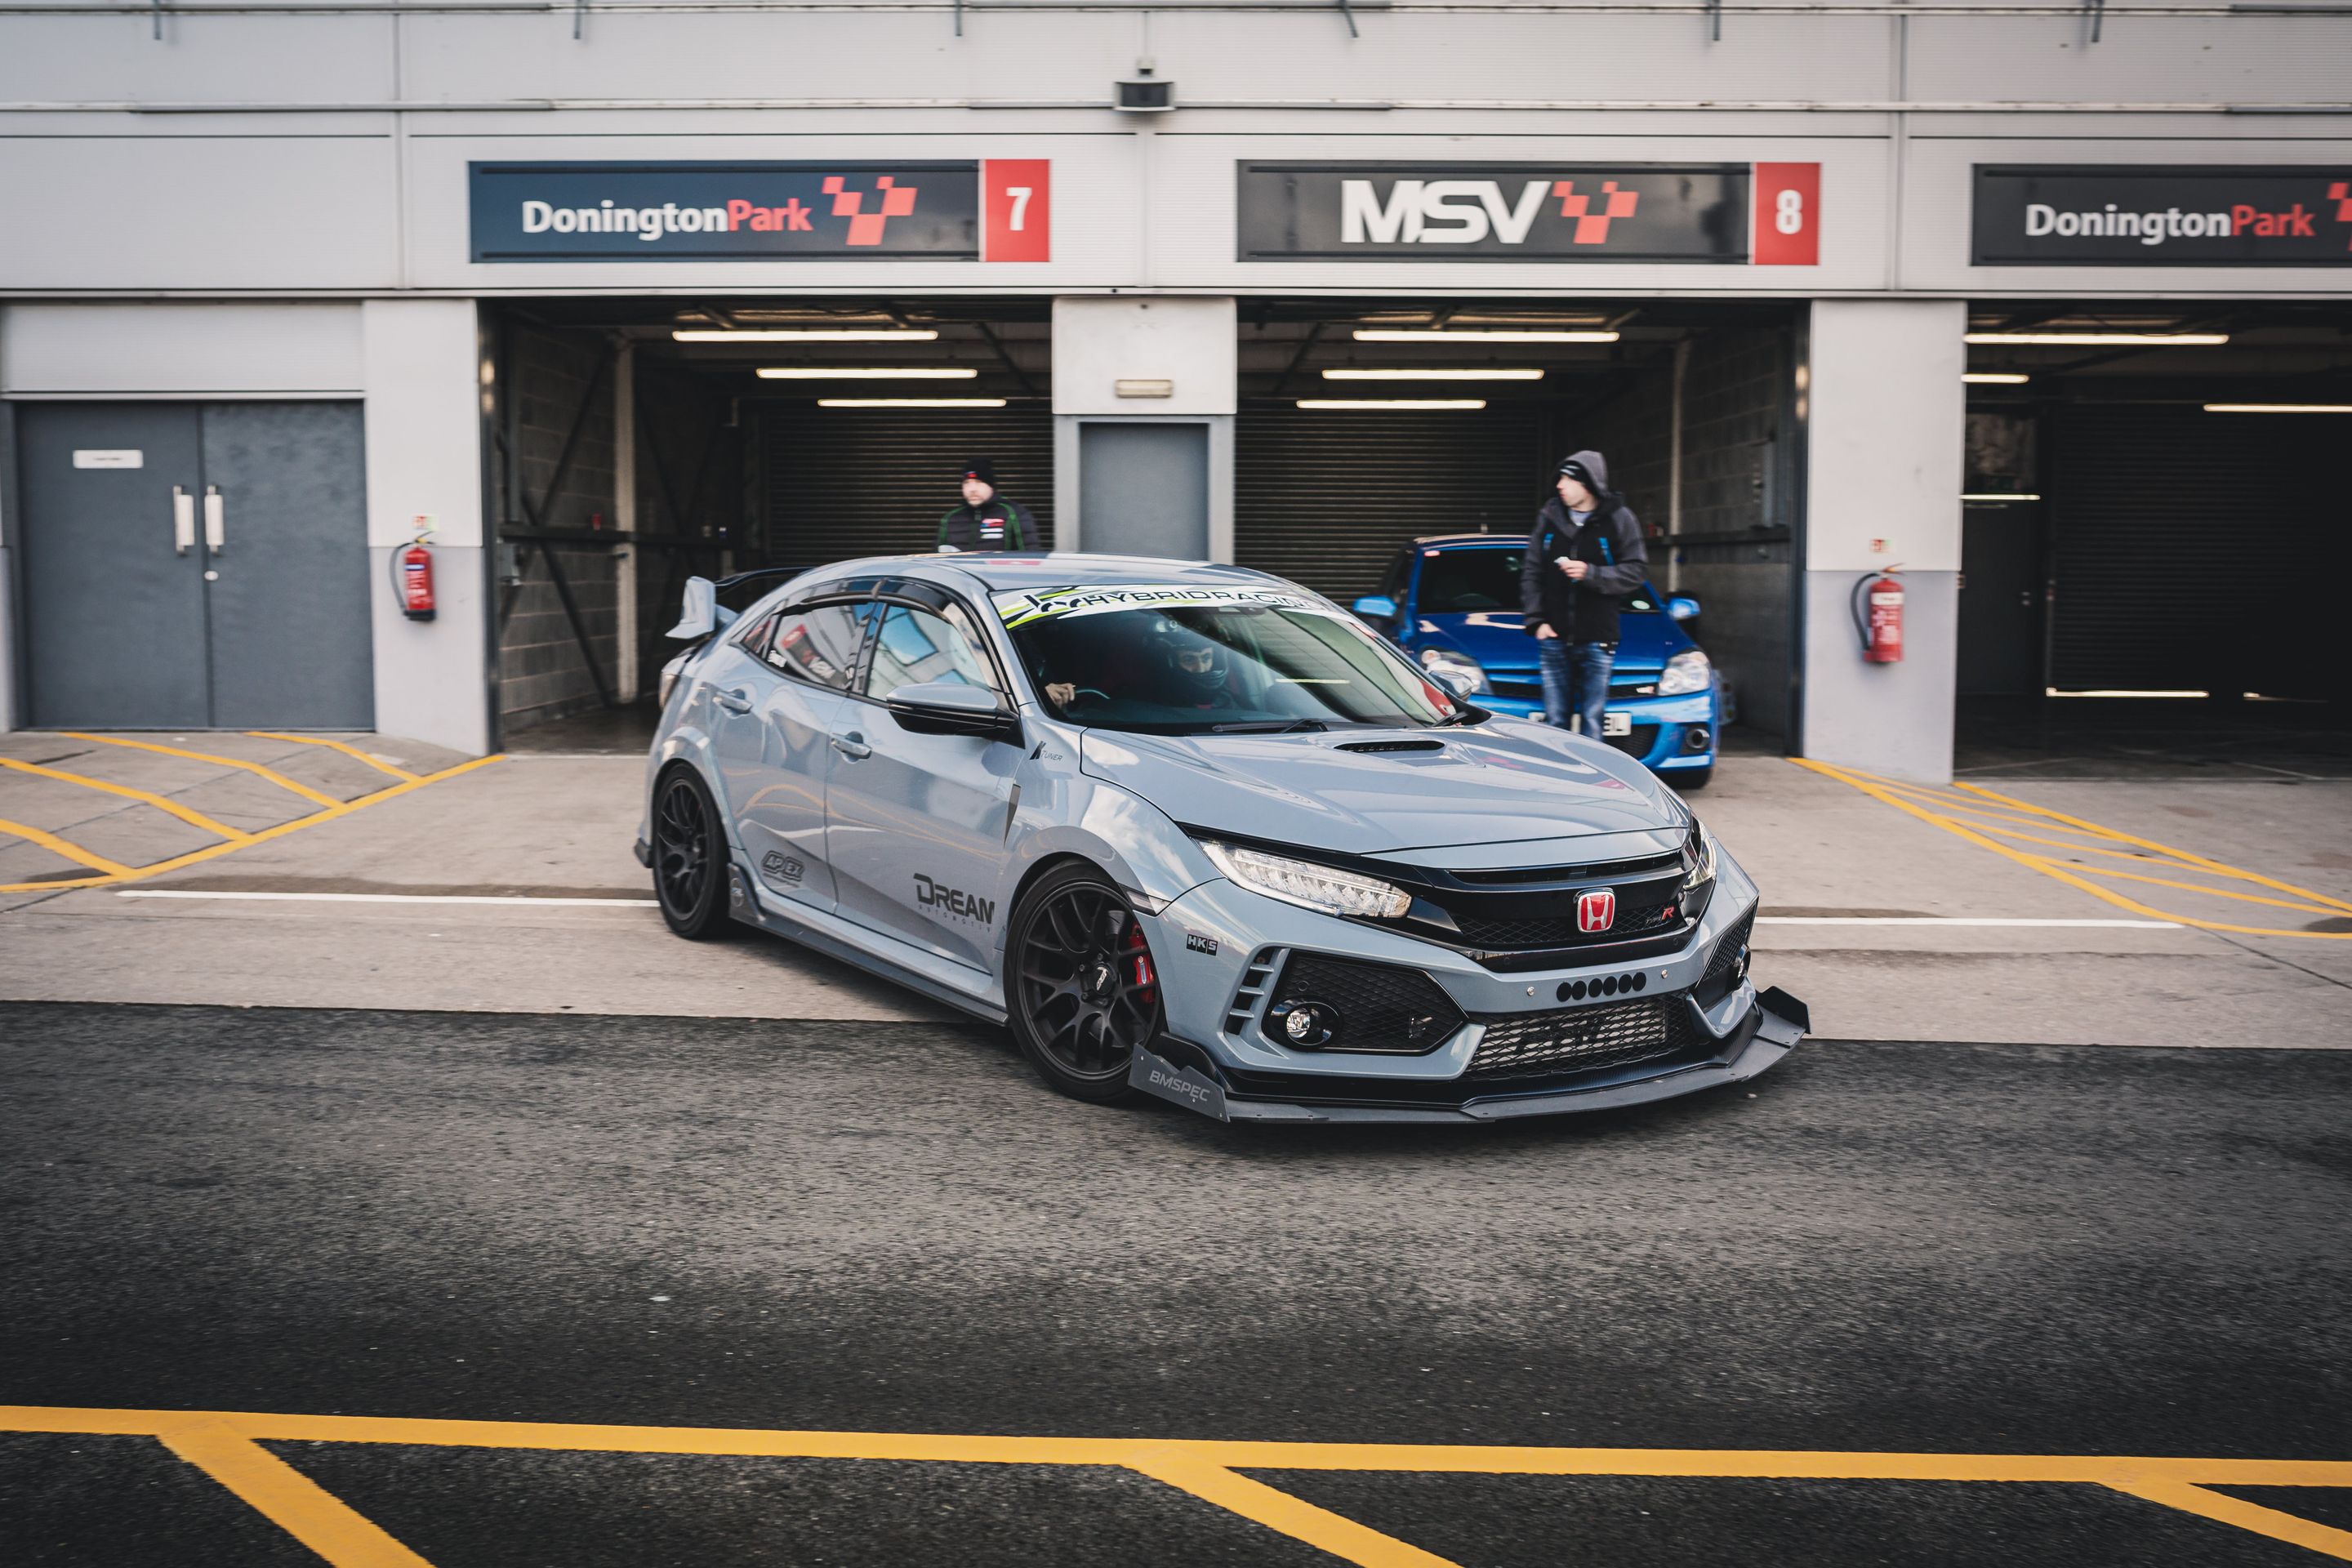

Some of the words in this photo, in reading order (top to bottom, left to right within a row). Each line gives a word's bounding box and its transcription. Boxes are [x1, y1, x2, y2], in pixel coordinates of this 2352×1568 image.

[1005, 186, 1032, 231] 7
[1341, 179, 1552, 244] MSV
[1775, 189, 1802, 234] 8
[1661, 906, 1674, 920] R
[1187, 935, 1217, 952] HKS
[1149, 1070, 1210, 1102] BMSPEC
